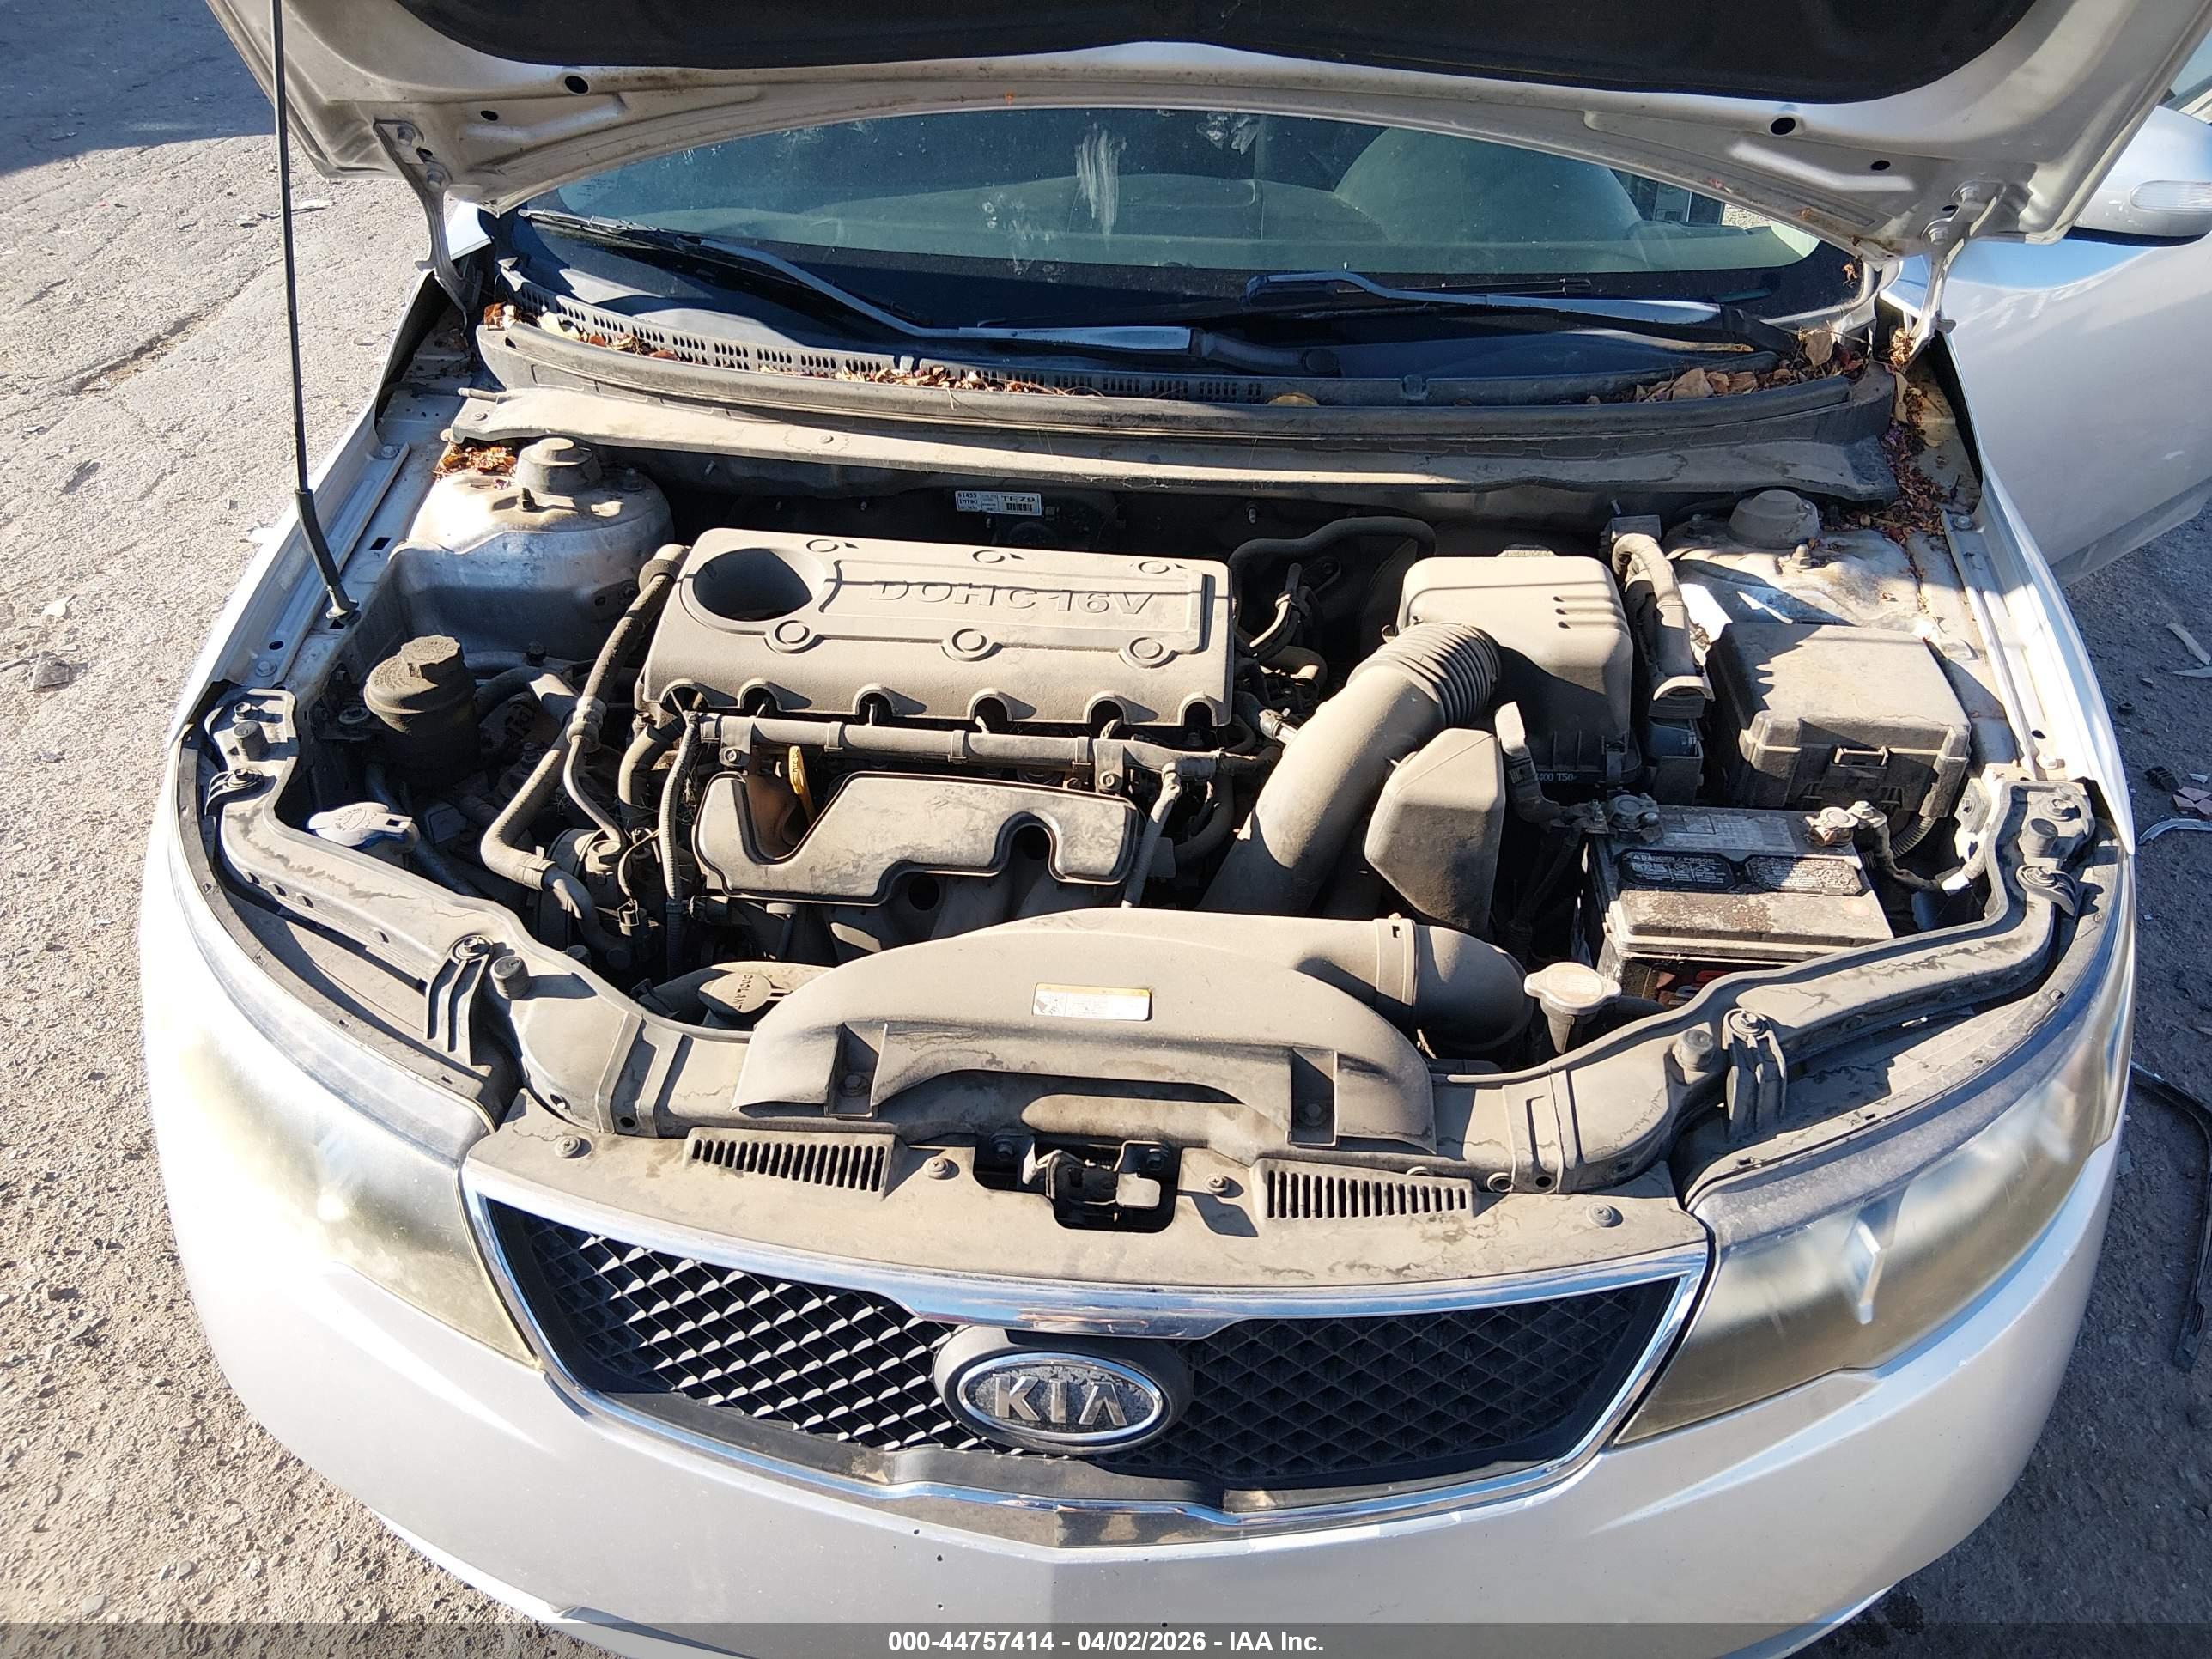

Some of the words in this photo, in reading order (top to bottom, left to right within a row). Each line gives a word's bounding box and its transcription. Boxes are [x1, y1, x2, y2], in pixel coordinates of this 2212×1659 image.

[868, 580, 1038, 610] DOHC
[1048, 590, 1154, 616] 16V
[732, 974, 754, 1011] COOLANT
[992, 1371, 1129, 1427] KIA
